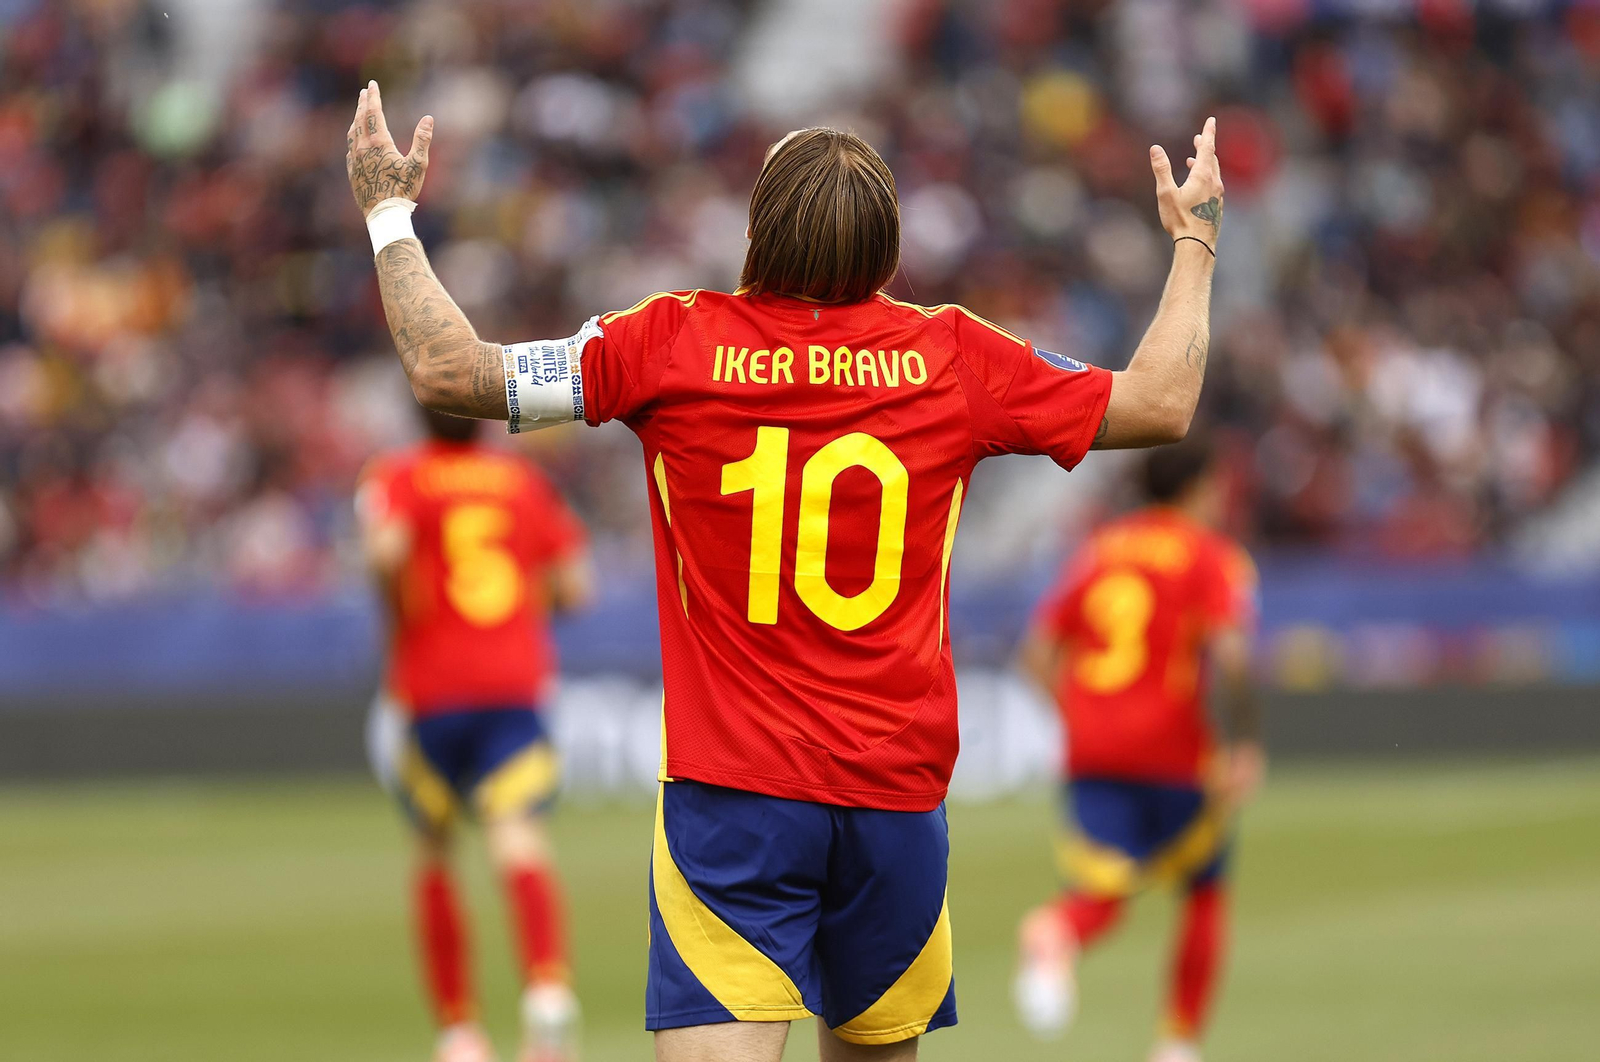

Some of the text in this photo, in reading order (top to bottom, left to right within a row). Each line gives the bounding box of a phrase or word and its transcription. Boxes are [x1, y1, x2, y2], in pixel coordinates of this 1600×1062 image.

[518, 356, 528, 373] FIFA
[528, 346, 544, 387] the World
[541, 345, 558, 383] UNITES
[556, 345, 568, 382] FOOTBALL
[712, 345, 928, 387] IKER BRAVO
[720, 425, 909, 632] 10
[443, 504, 522, 627] 5
